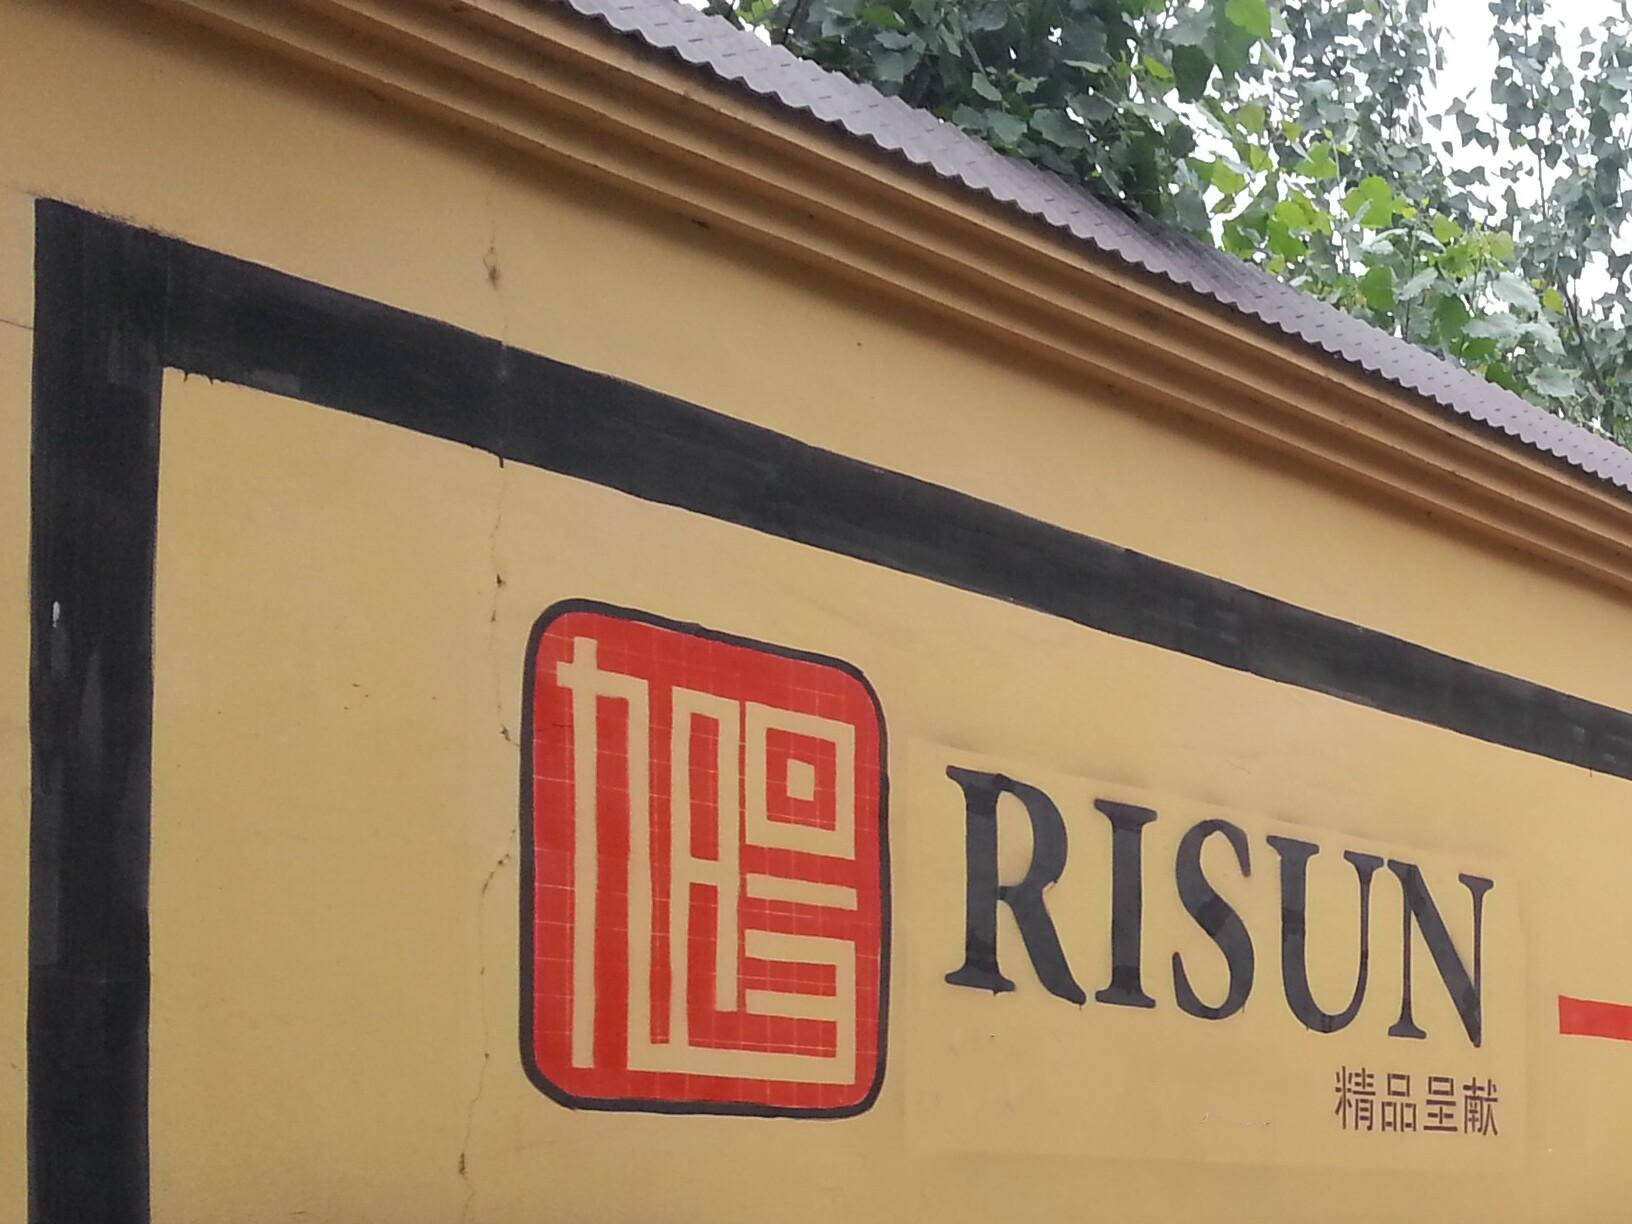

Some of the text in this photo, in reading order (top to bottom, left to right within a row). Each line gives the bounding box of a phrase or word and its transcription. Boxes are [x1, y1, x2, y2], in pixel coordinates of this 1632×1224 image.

[944, 765, 1494, 1048] RISUN
[1334, 1065, 1499, 1136] 精品呈献
